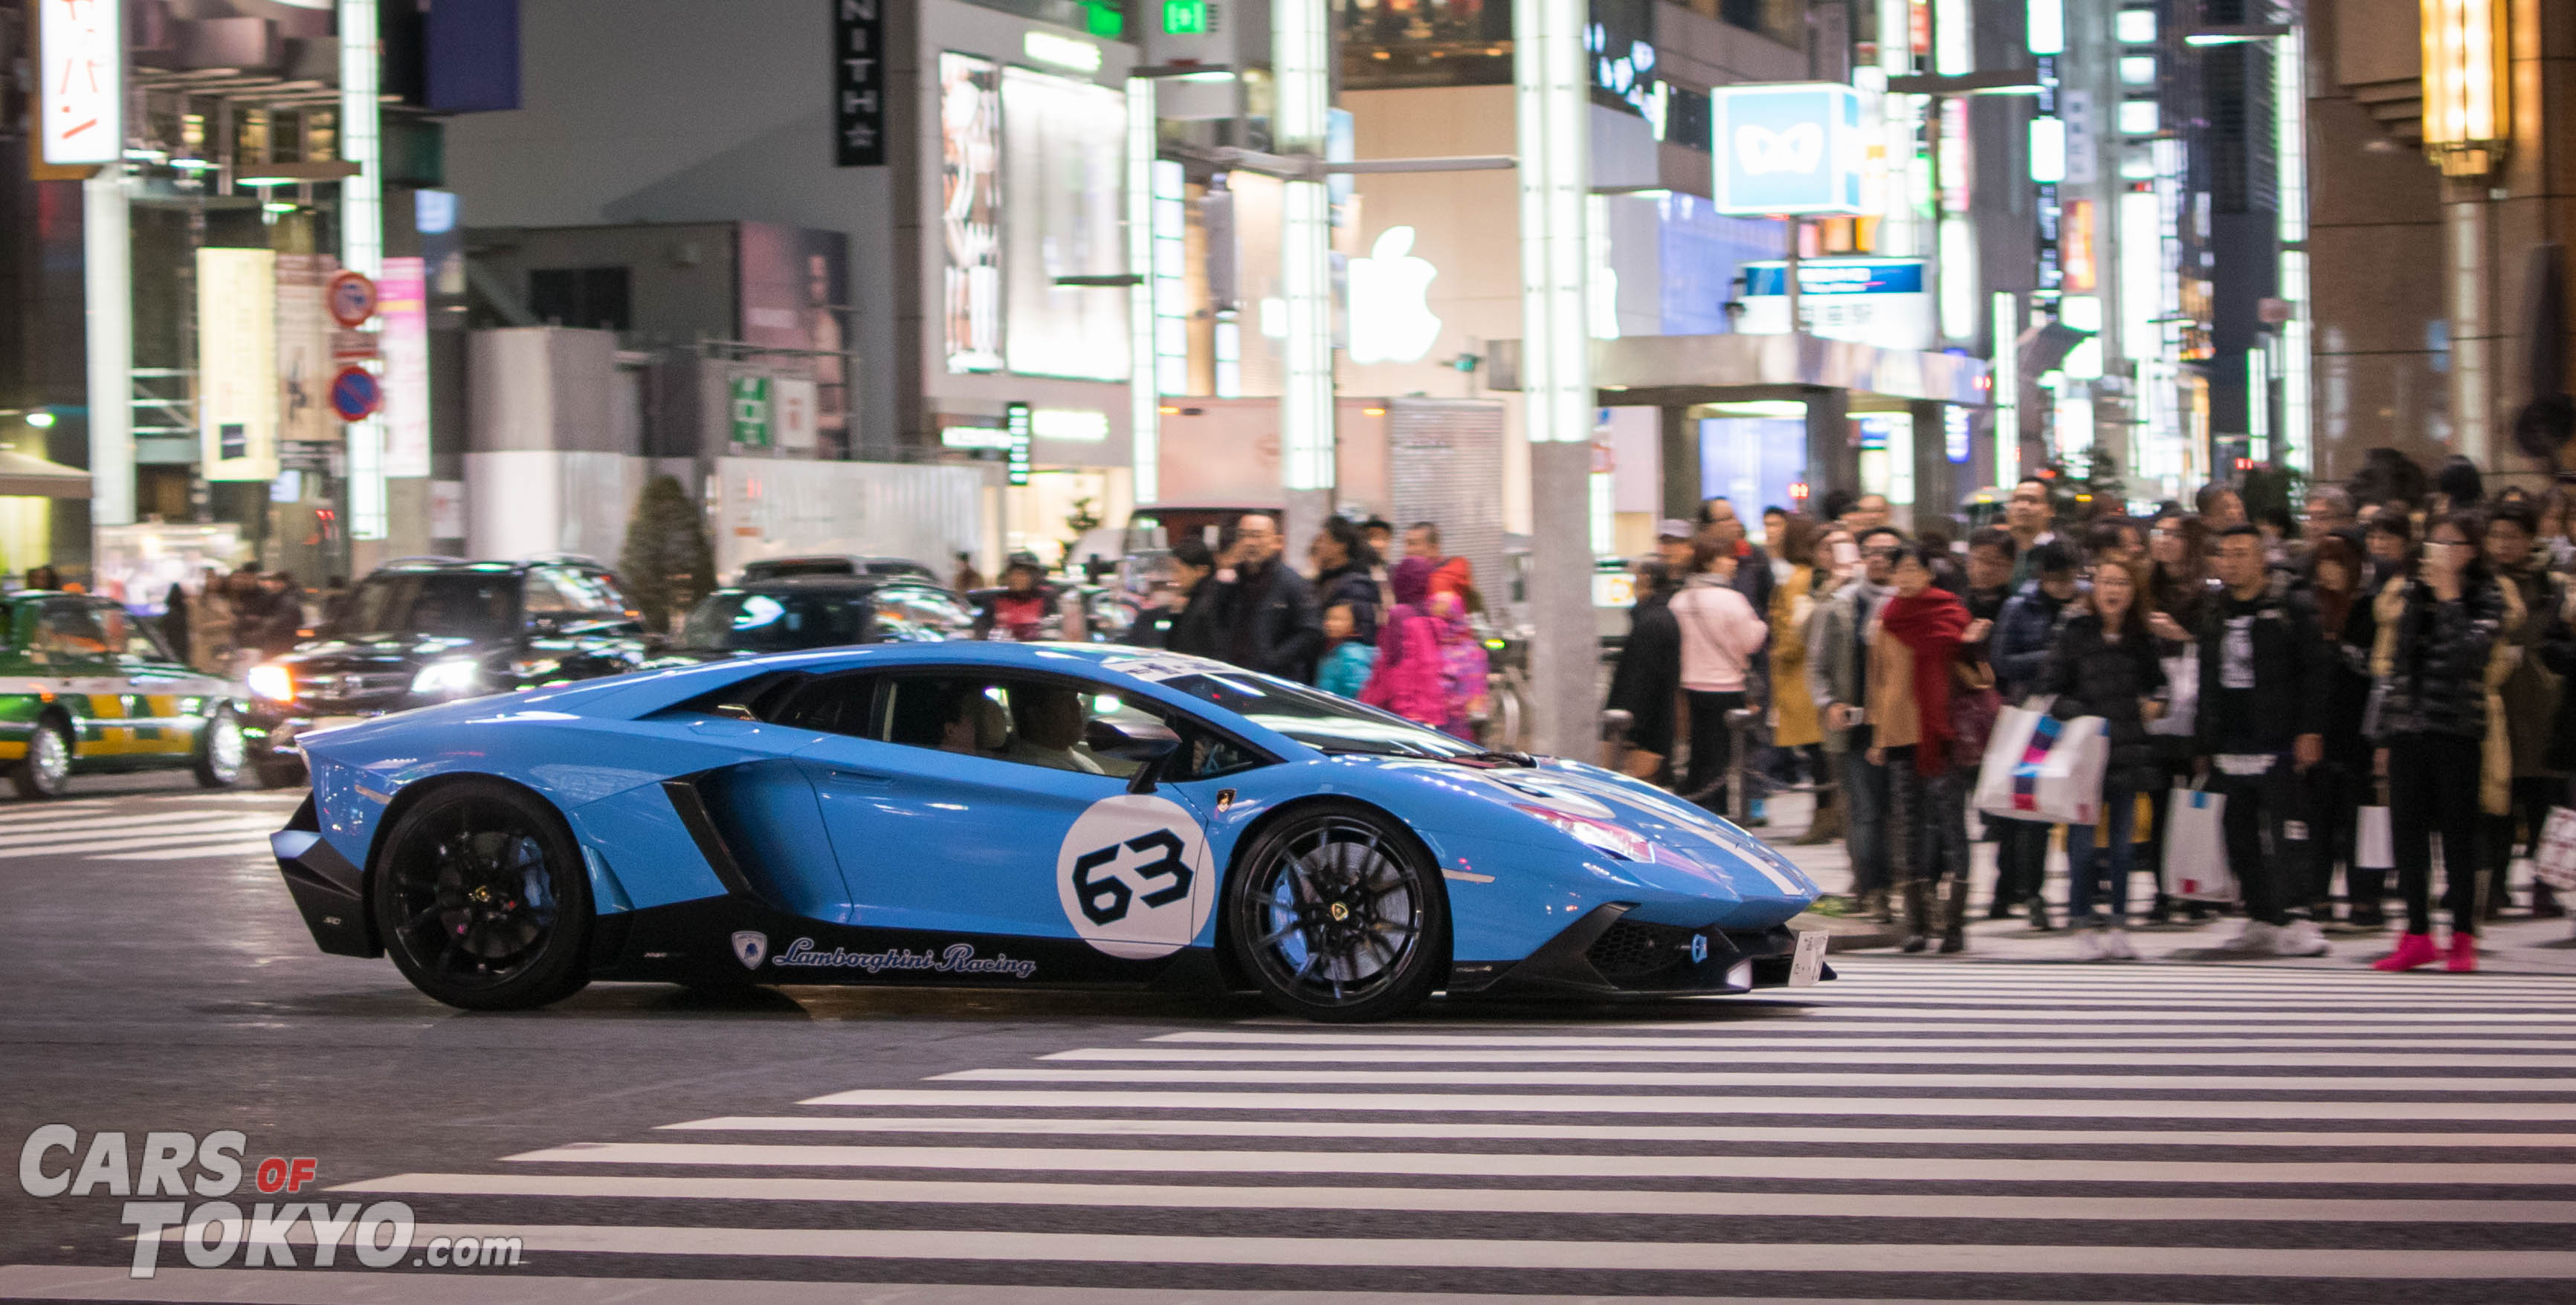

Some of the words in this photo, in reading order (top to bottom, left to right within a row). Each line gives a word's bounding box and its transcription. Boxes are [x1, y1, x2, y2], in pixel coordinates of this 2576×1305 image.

[1071, 827, 1195, 927] 63
[772, 937, 934, 974] Lamborghini
[934, 943, 1037, 979] Racing
